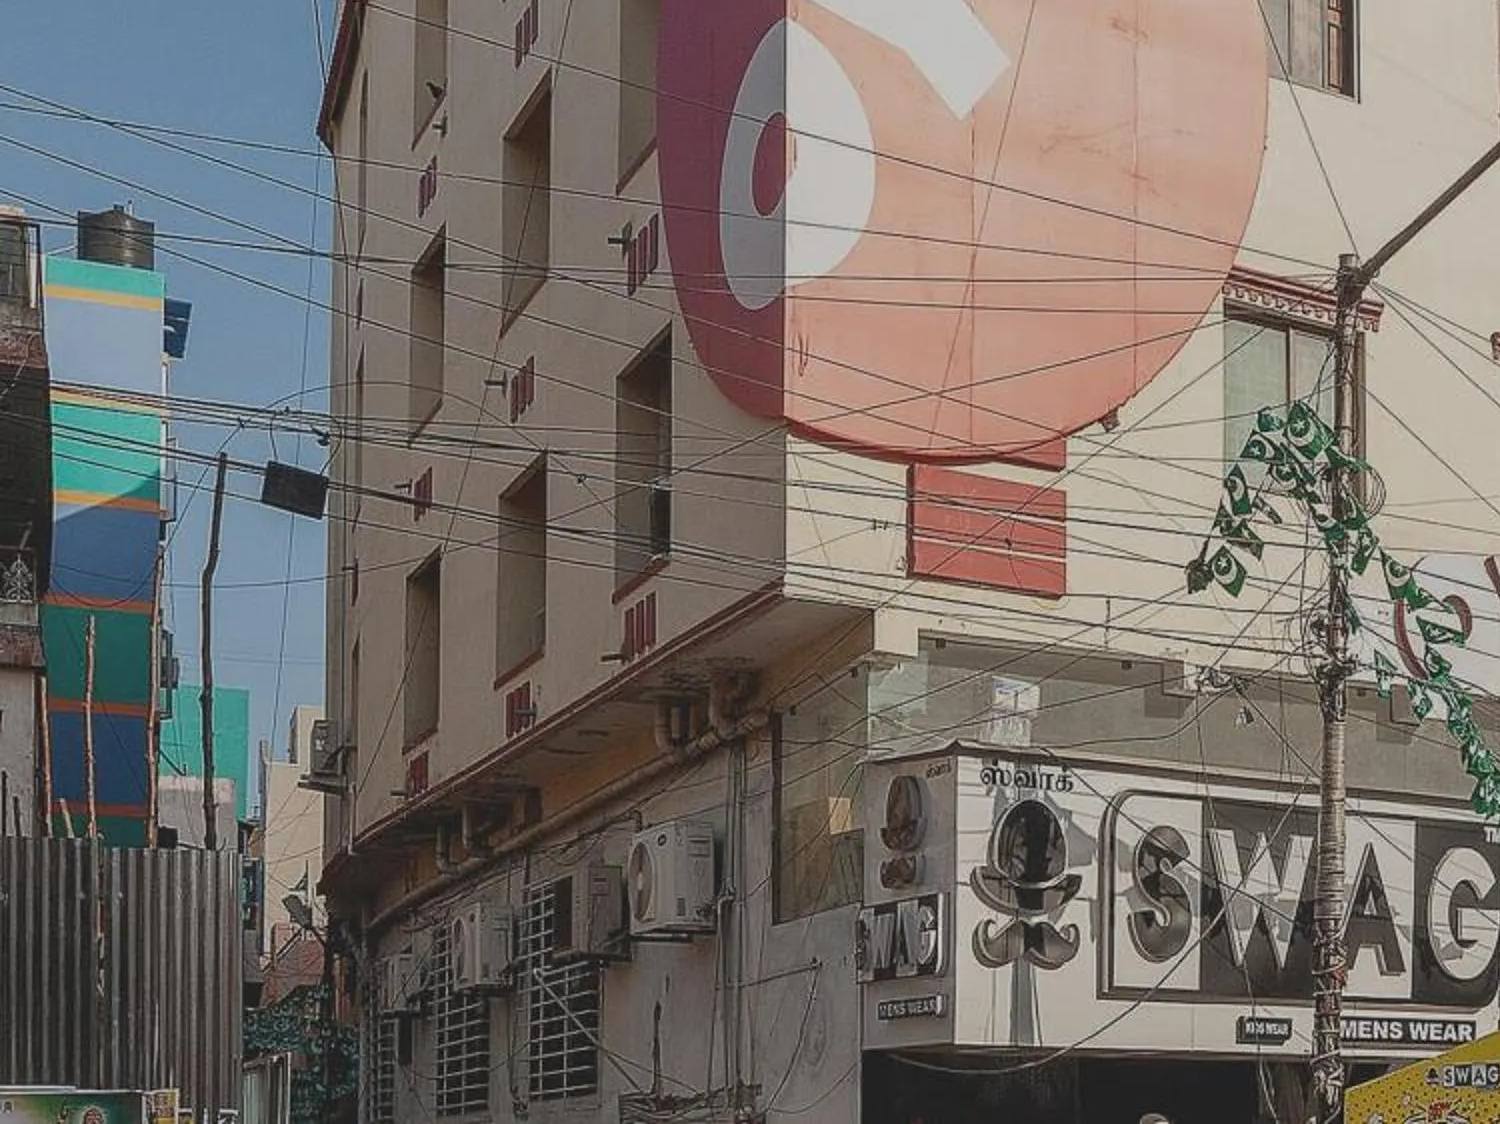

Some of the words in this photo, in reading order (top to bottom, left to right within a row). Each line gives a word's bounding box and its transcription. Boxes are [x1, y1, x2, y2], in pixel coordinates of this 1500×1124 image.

[1128, 825, 1500, 980] SWAG
[1340, 1019, 1403, 1040] MENS
[1409, 1021, 1474, 1042] WEAR
[1442, 1064, 1500, 1088] SWAG
